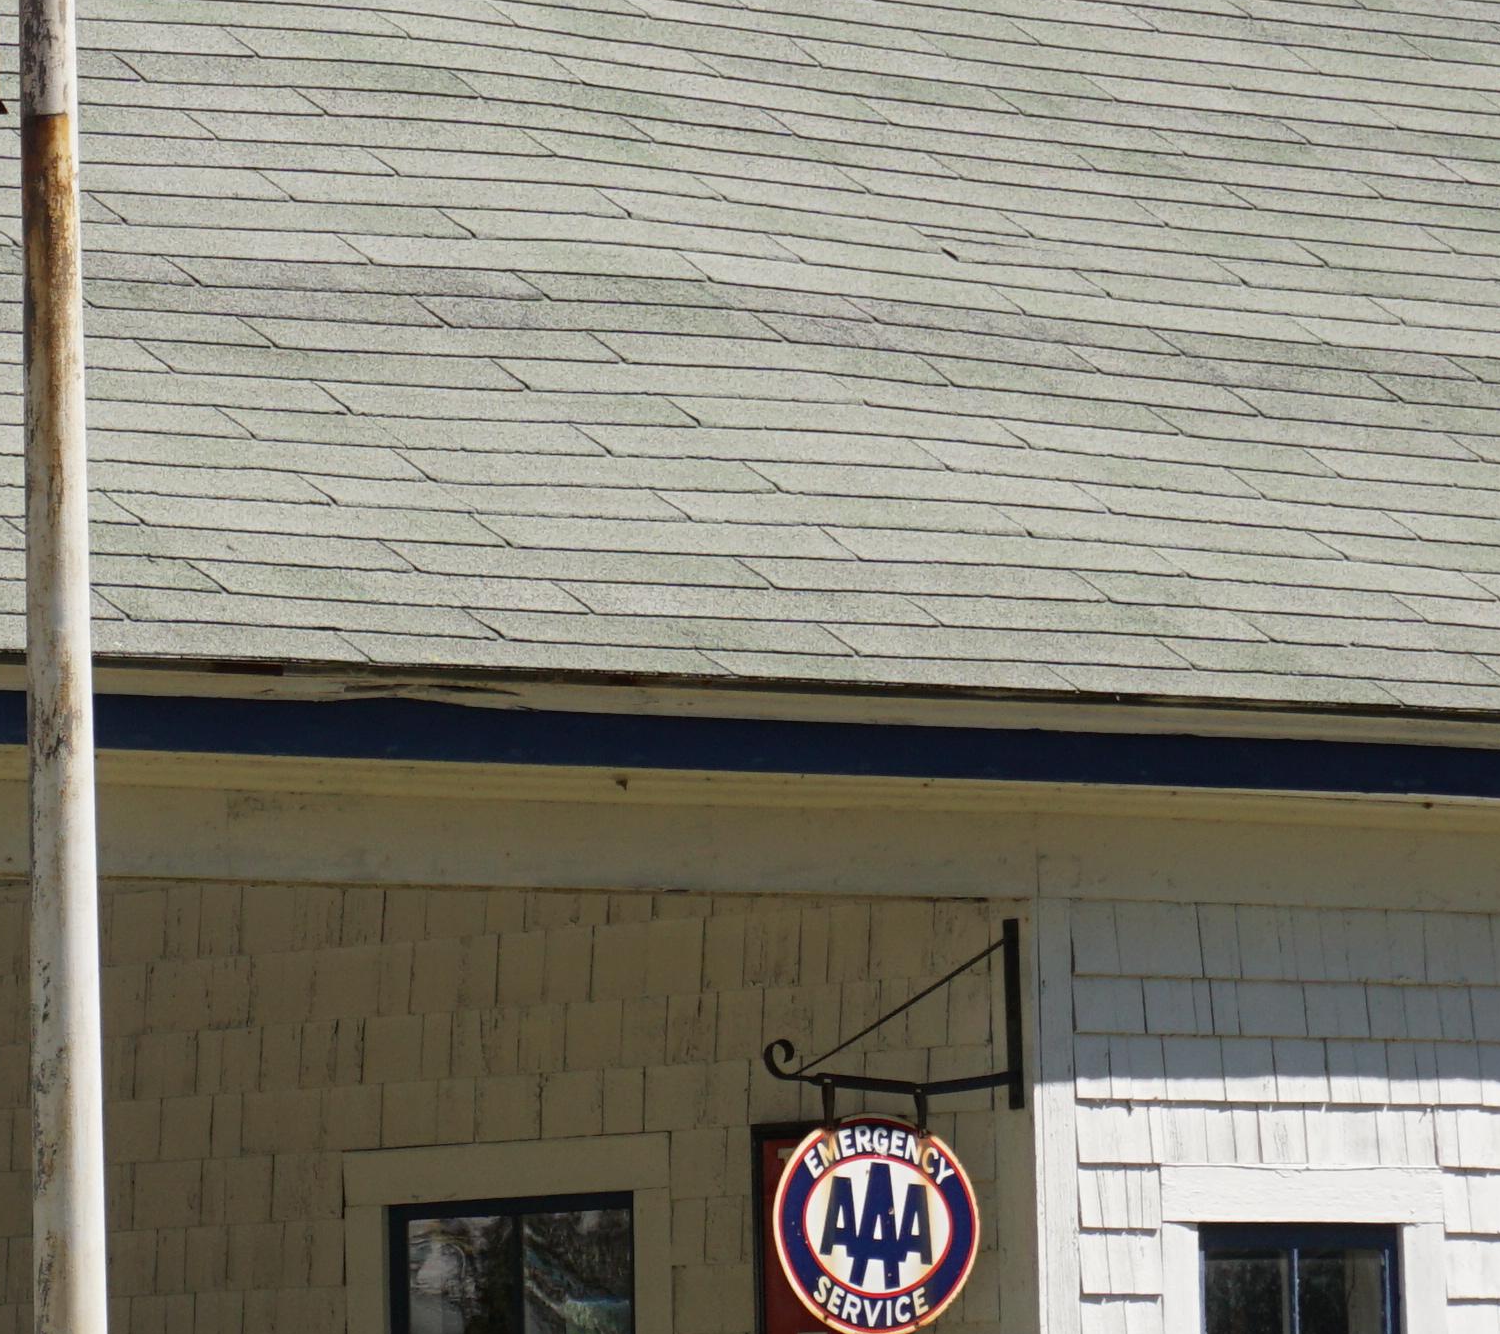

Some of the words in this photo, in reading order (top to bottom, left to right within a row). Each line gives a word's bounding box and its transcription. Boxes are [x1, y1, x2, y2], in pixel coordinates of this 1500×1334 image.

[804, 1125, 955, 1185] EMERGENCY
[819, 1162, 933, 1290] AAA
[813, 1275, 930, 1327] SERVICE
